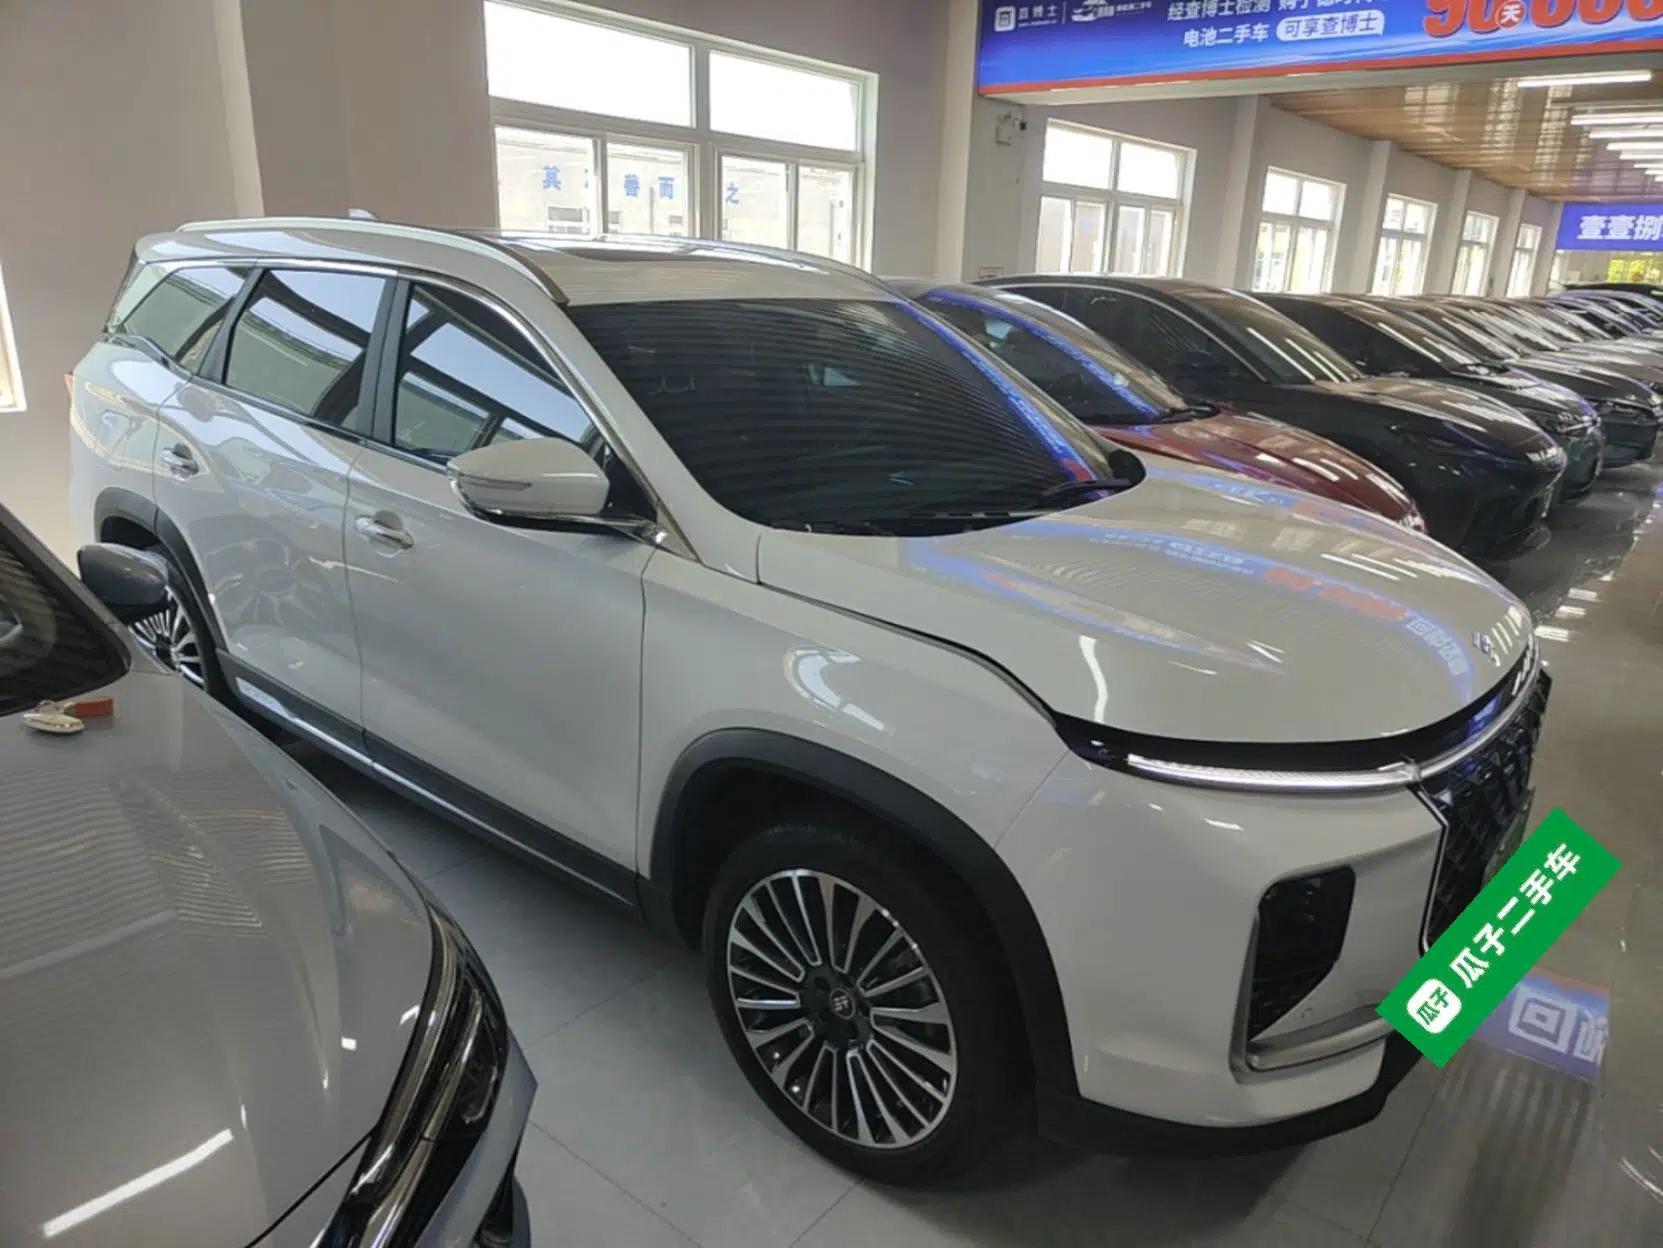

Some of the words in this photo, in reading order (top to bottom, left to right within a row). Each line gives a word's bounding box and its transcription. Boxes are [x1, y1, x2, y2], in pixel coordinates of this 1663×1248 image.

[1183, 23, 1270, 48] 电池二手车
[1284, 14, 1378, 38] 可享查博士
